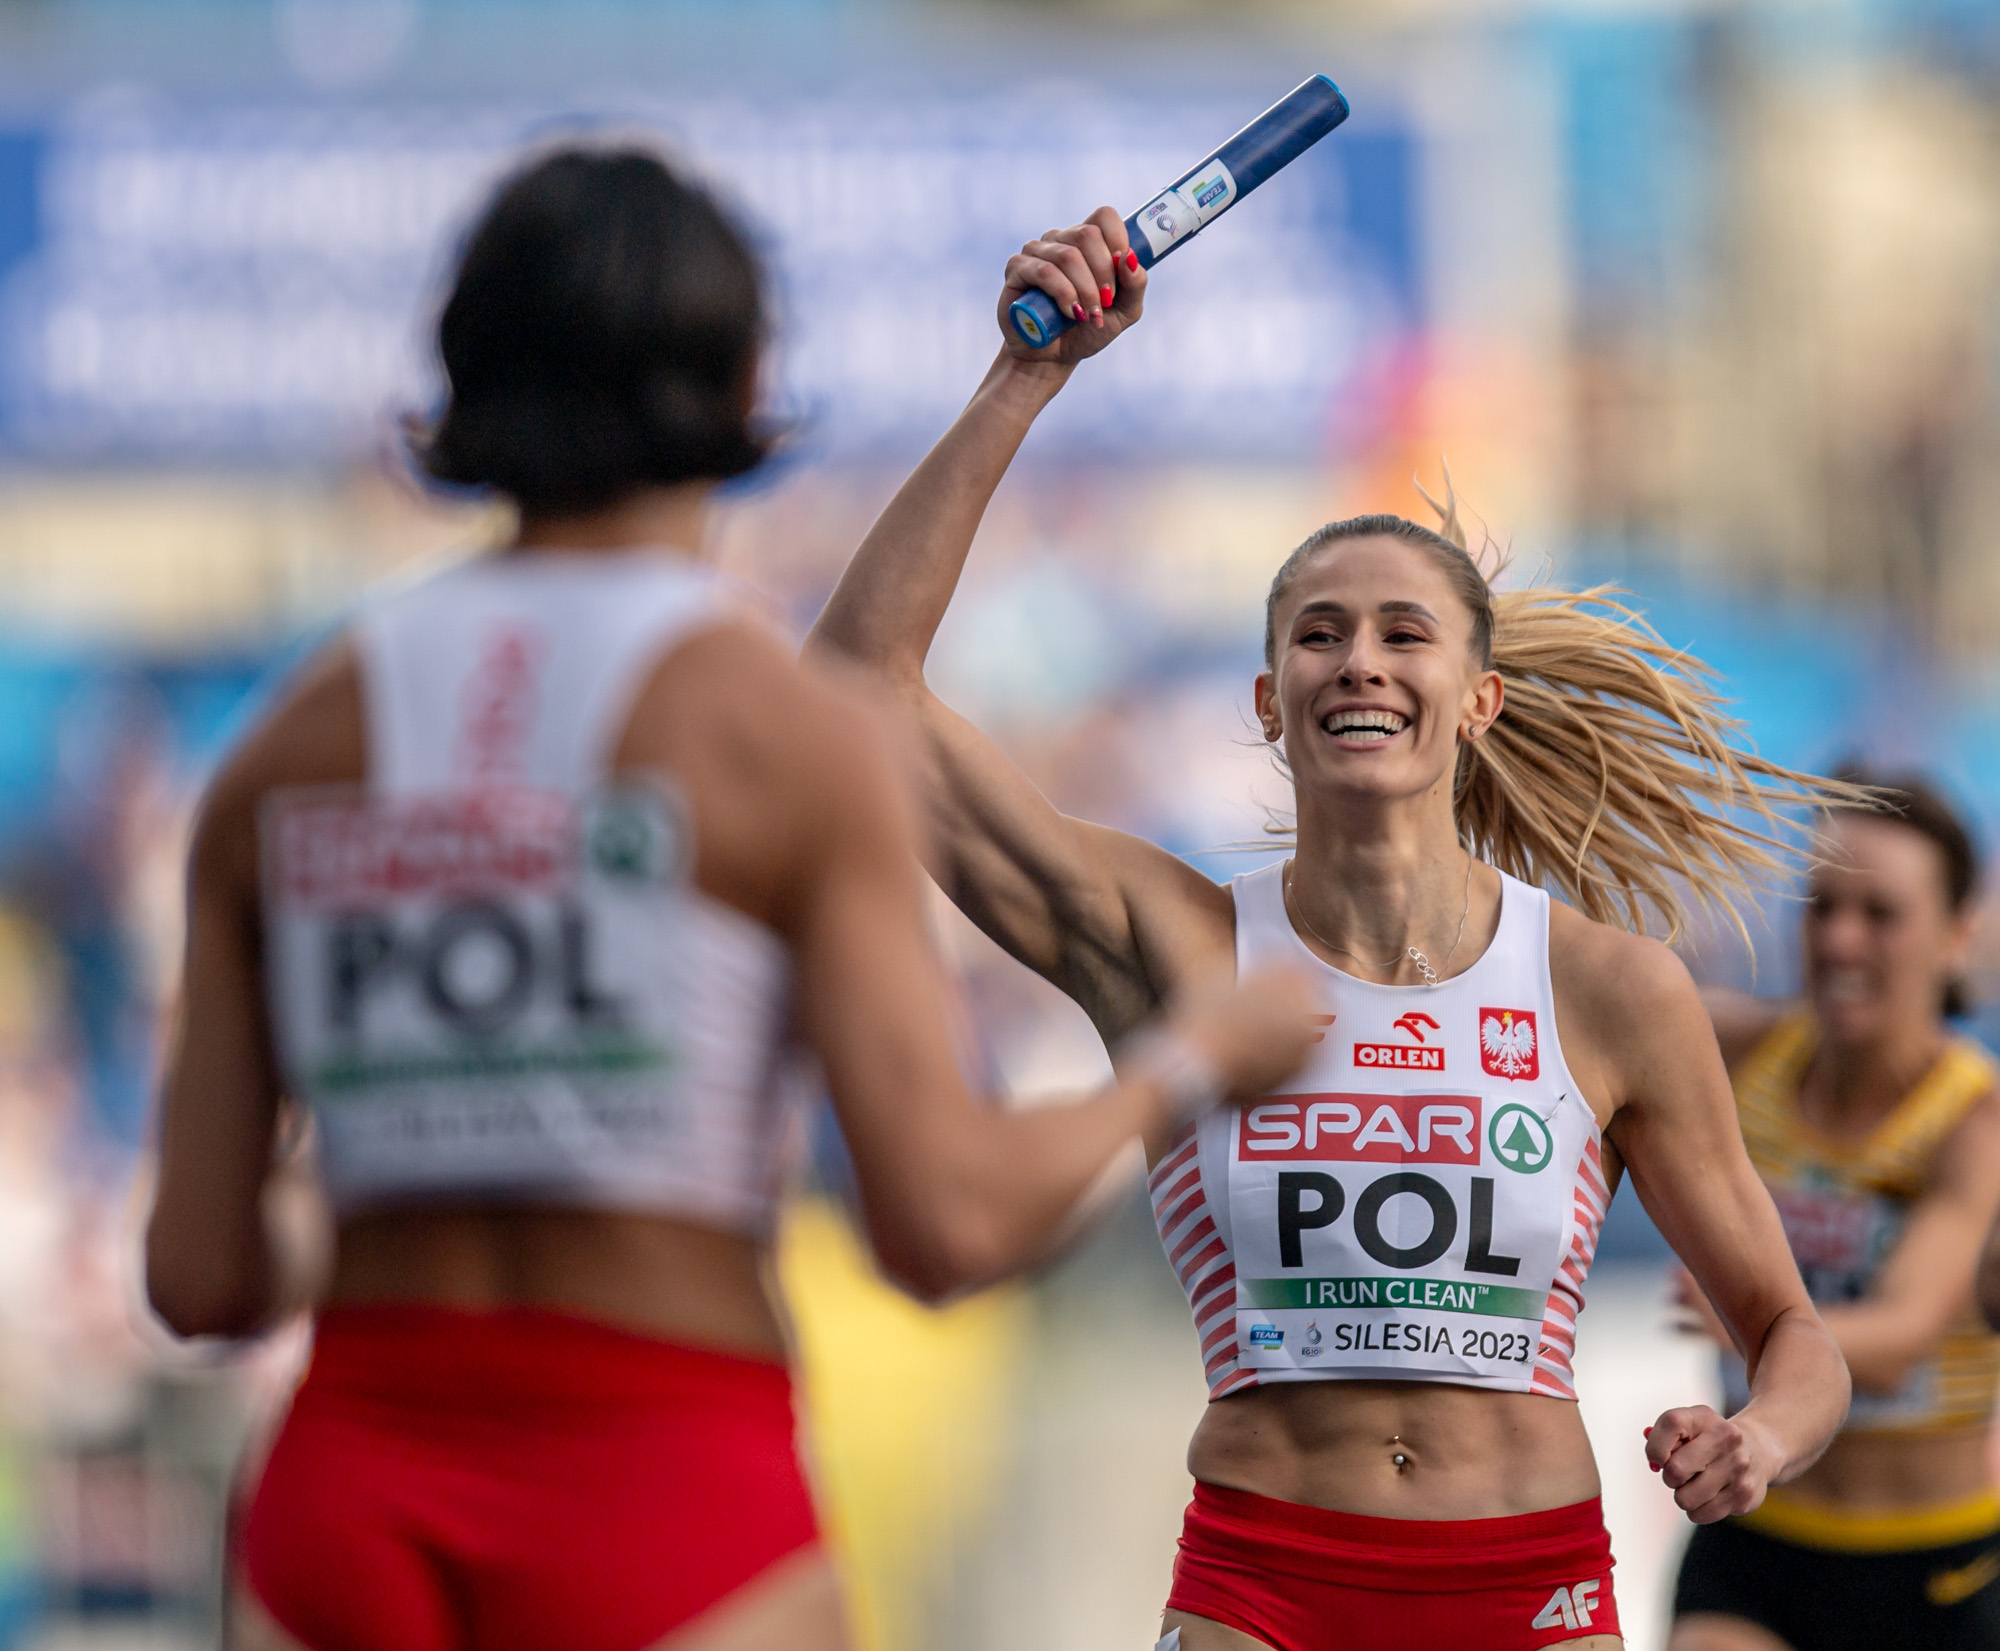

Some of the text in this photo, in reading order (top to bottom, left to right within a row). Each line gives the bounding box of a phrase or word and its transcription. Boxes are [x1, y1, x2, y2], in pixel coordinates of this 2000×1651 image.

[325, 895, 630, 1035] POL
[1358, 1046, 1440, 1068] ORLEN
[1246, 1102, 1474, 1155] SPAR
[1278, 1171, 1522, 1277] POL
[1305, 1282, 1311, 1304] I
[1319, 1281, 1378, 1304] RUN
[1255, 1331, 1278, 1339] TEAM
[1335, 1323, 1530, 1363] SILESIA 2023
